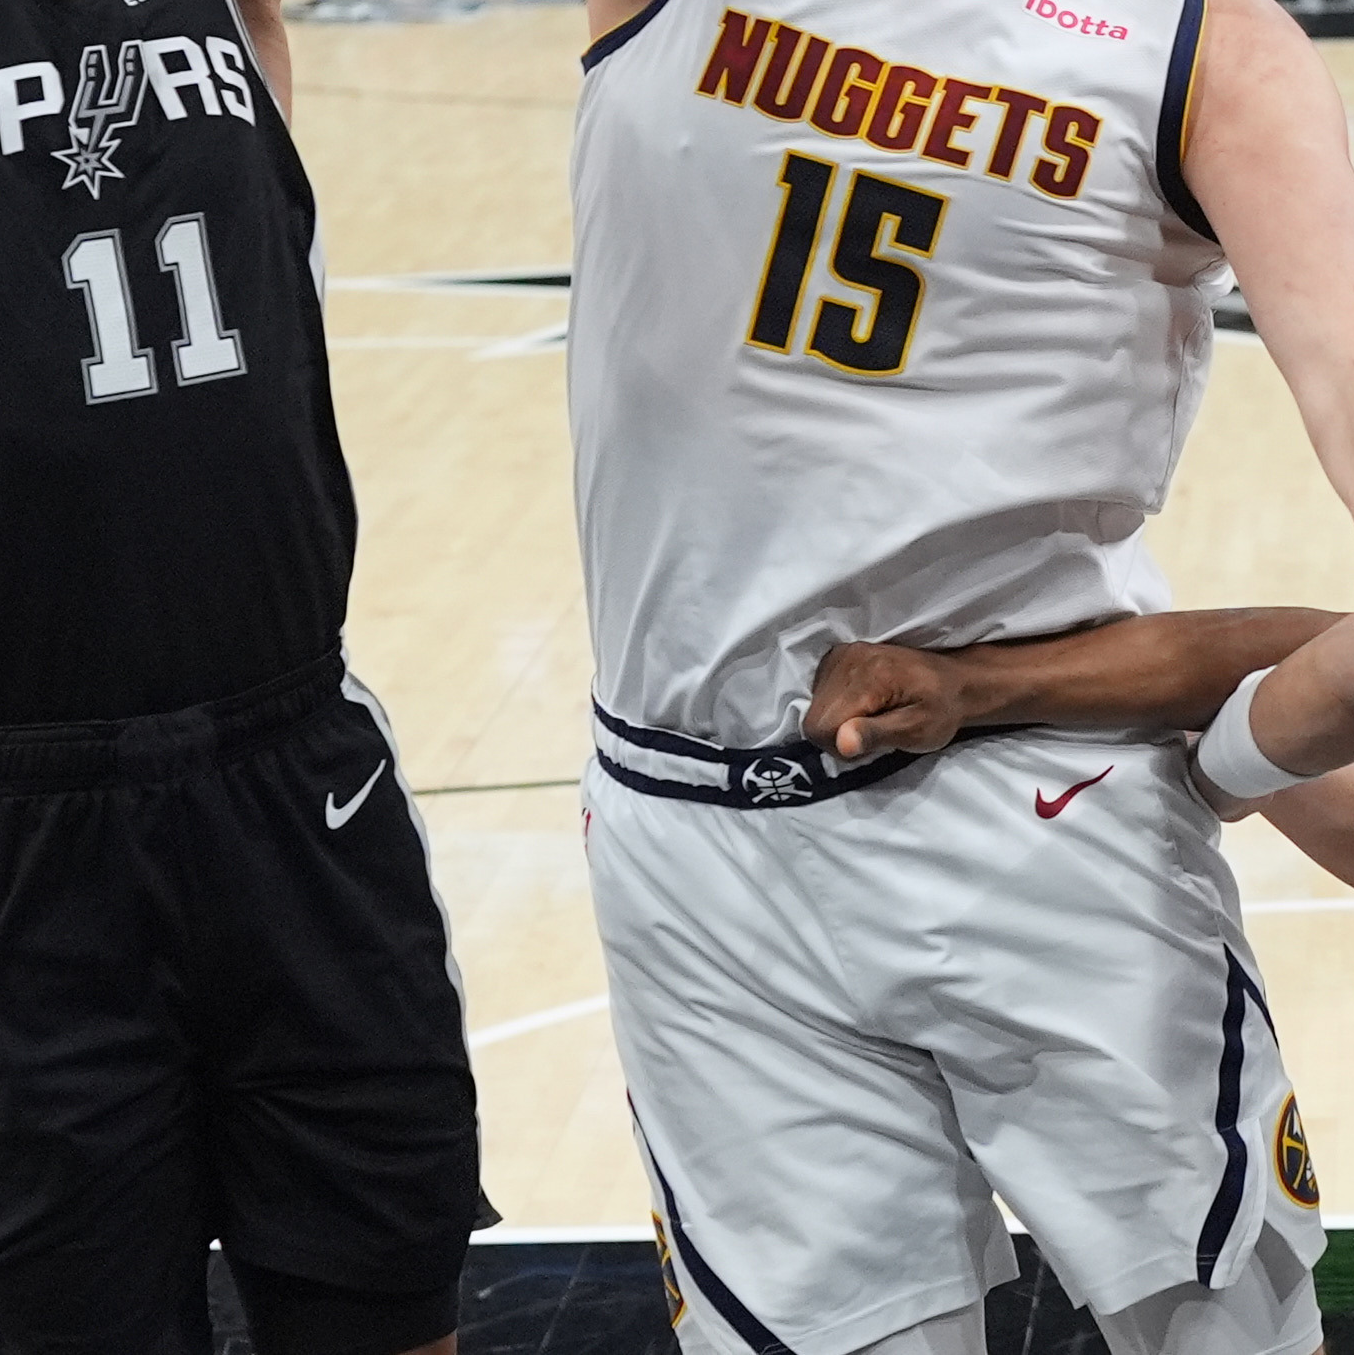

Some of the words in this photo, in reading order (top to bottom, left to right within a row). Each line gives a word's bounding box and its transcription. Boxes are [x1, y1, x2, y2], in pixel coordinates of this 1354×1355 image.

[694, 5, 1104, 200] NUGGETS
[61, 211, 248, 406] 11
[746, 147, 950, 377] 15
